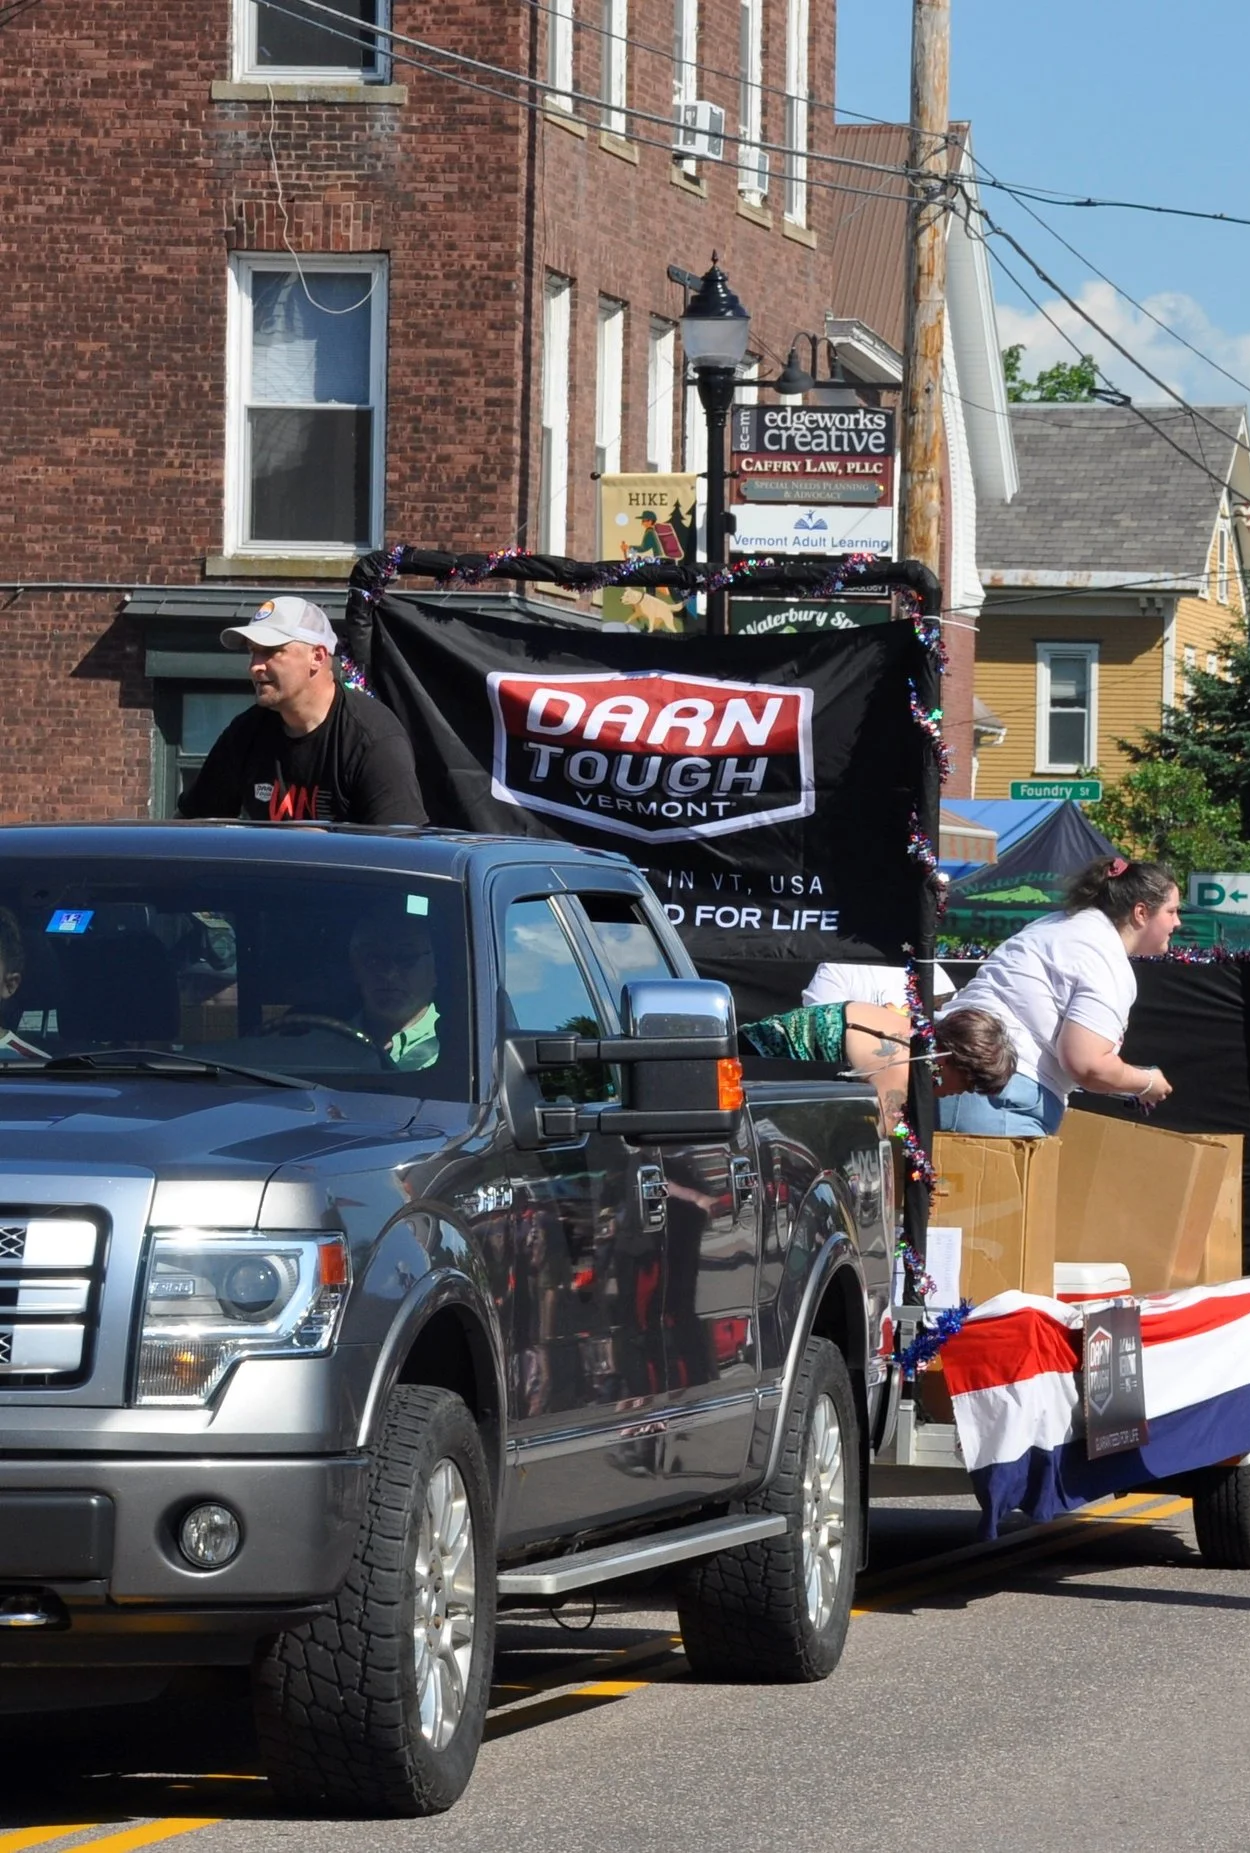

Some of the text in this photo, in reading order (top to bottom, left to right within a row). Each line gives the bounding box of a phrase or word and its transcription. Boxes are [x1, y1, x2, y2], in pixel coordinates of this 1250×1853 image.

[764, 407, 886, 431] edgeworks
[763, 427, 886, 453] creative
[741, 458, 883, 475] CAFFRY LAW, PLLC
[754, 480, 869, 491] SPECIAL NEEDS PLANNING
[794, 491, 842, 500] ADVOCACY
[628, 493, 668, 506] HIKE
[734, 535, 890, 550] Vermont Adult Learning
[738, 607, 828, 634] Waterbury
[526, 688, 783, 747] DARN
[523, 742, 768, 797] TOUGH
[576, 791, 731, 818] VERMONT
[1020, 785, 1090, 799] Foundry St
[667, 869, 694, 889] IN
[711, 872, 752, 895] VT,
[770, 875, 823, 895] USA
[695, 905, 762, 929] FOR
[772, 909, 840, 931] LIFE
